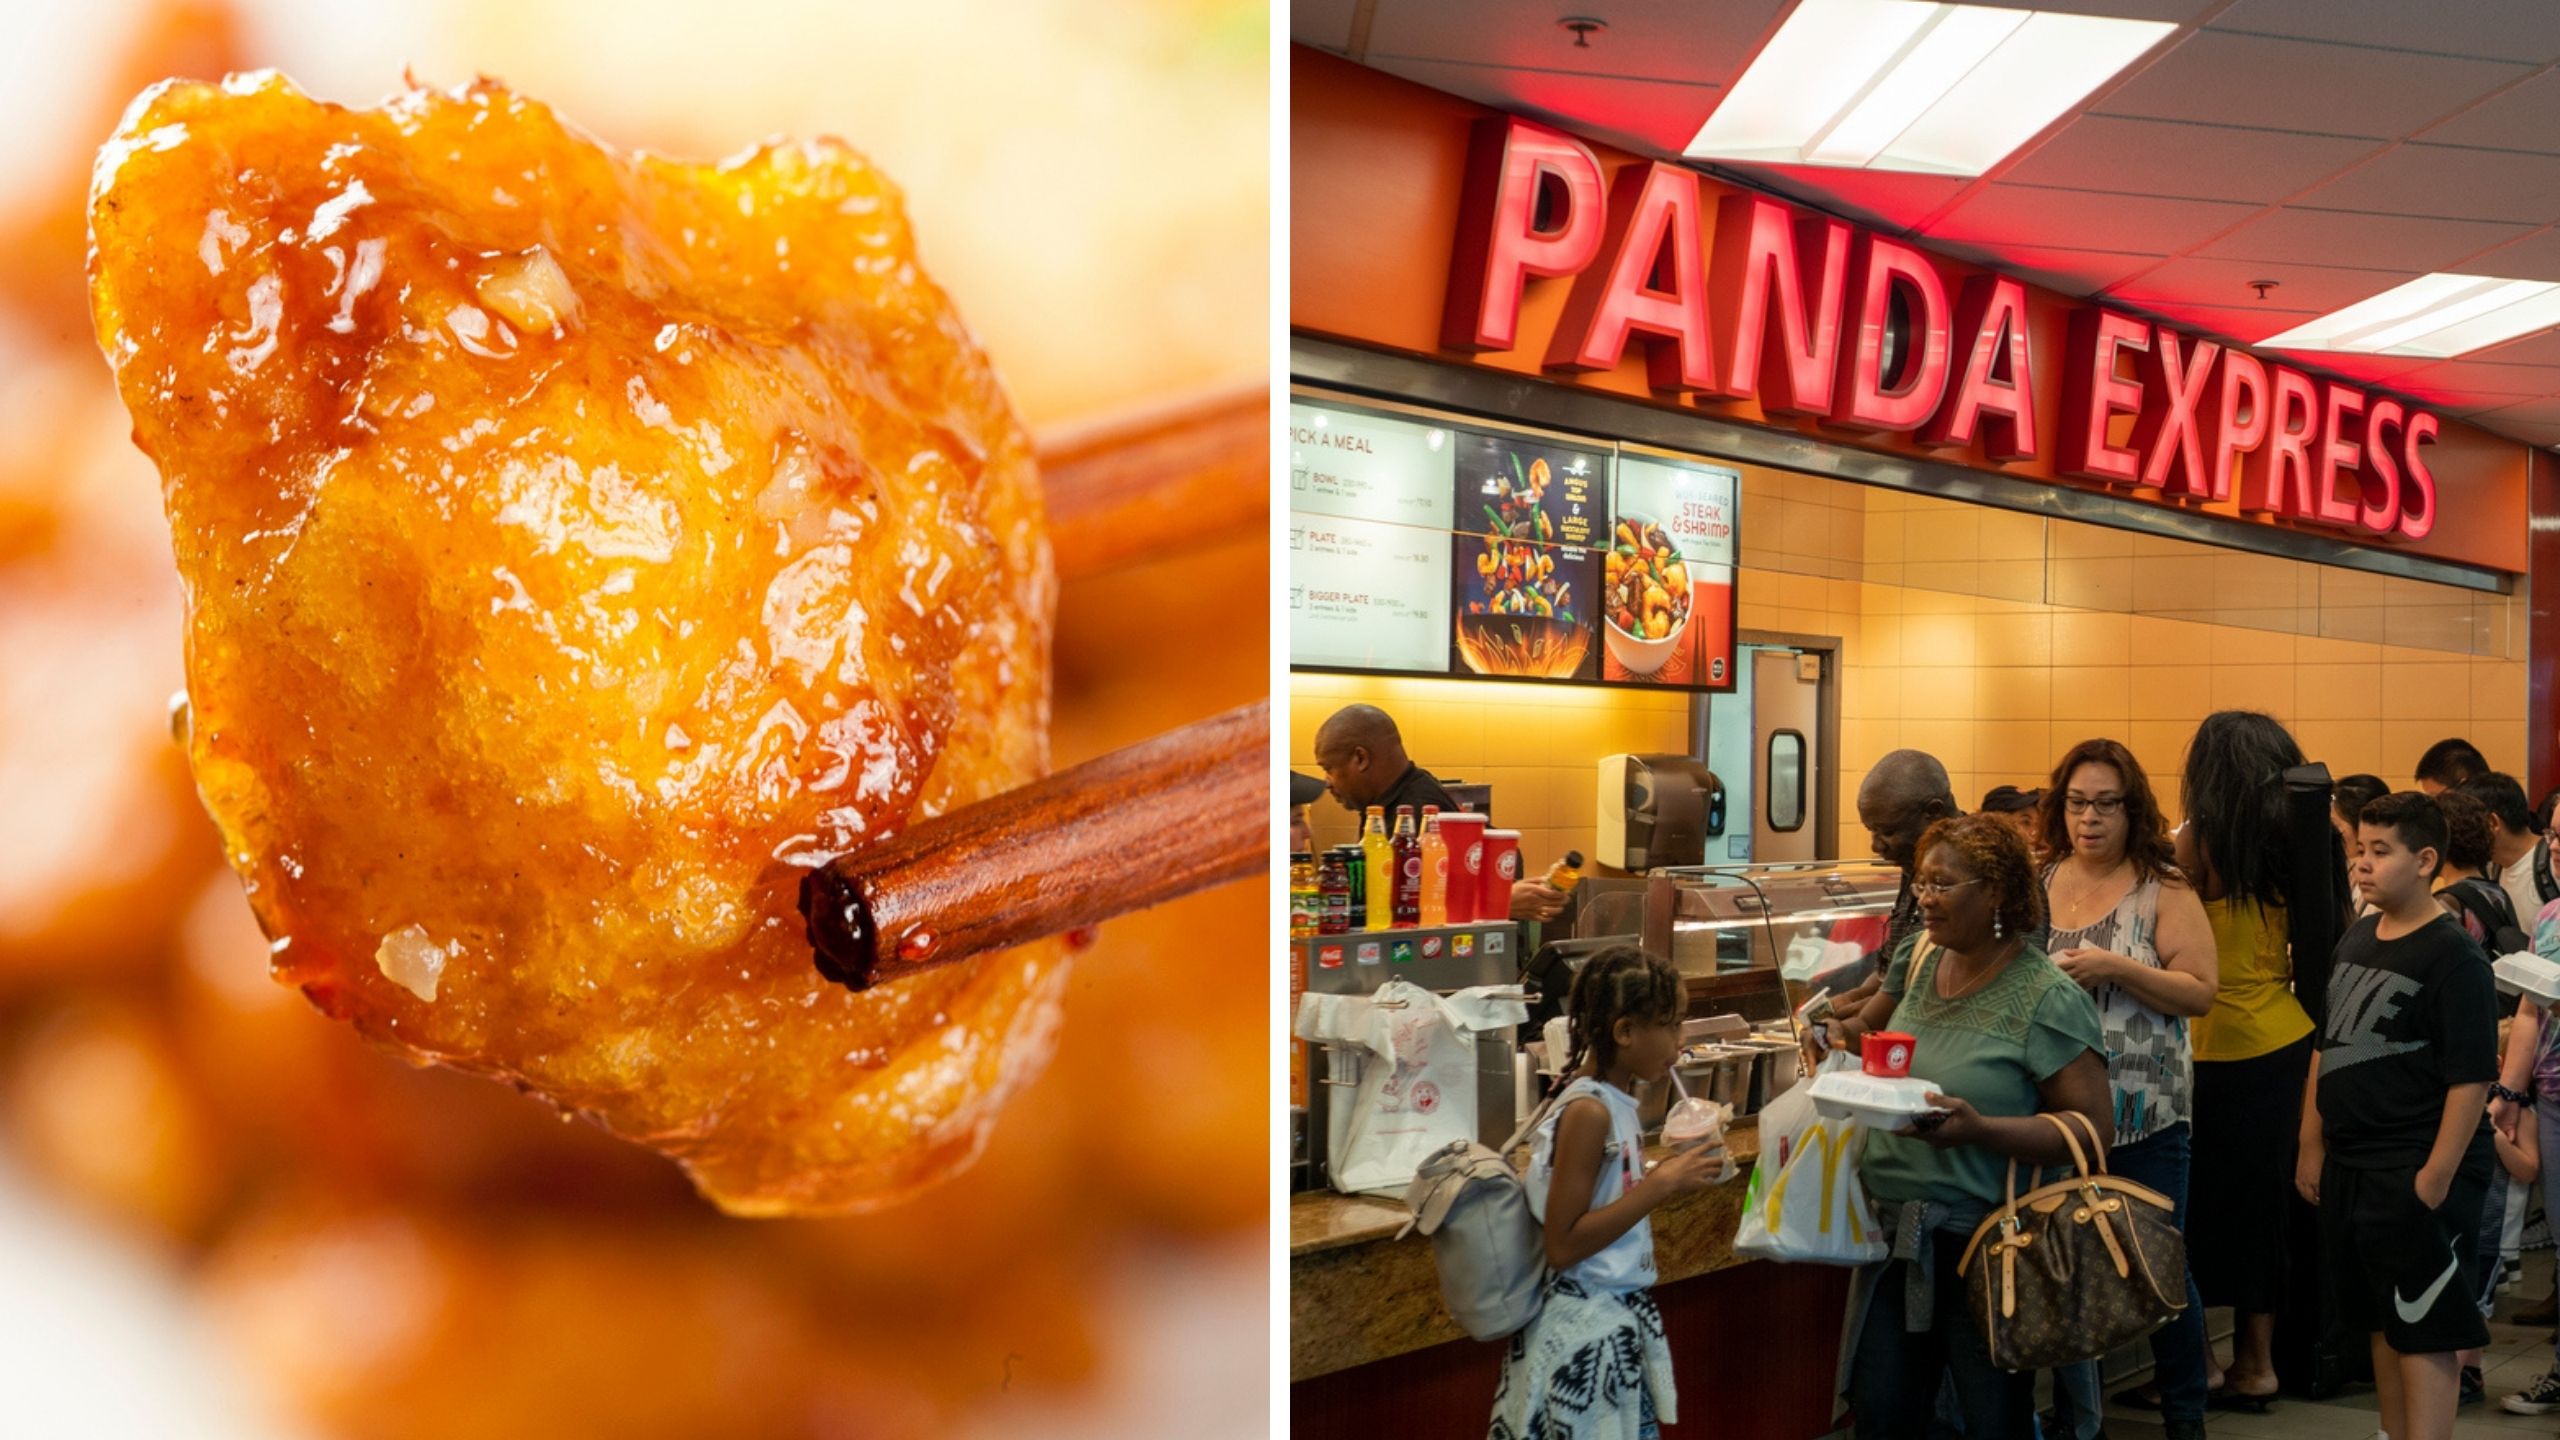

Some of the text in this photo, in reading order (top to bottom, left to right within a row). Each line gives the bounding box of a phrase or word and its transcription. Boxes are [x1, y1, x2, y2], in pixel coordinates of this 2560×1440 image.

[1476, 114, 2440, 541] PANDA EXPRESS
[1320, 430, 1330, 448] A
[1334, 433, 1373, 454] MEAL
[1313, 472, 1339, 486] BOWL
[1683, 502, 1721, 520] STEAK
[1309, 531, 1336, 544] PLATE
[1309, 590, 1341, 604] BIGGER
[1342, 592, 1369, 605] PLATE
